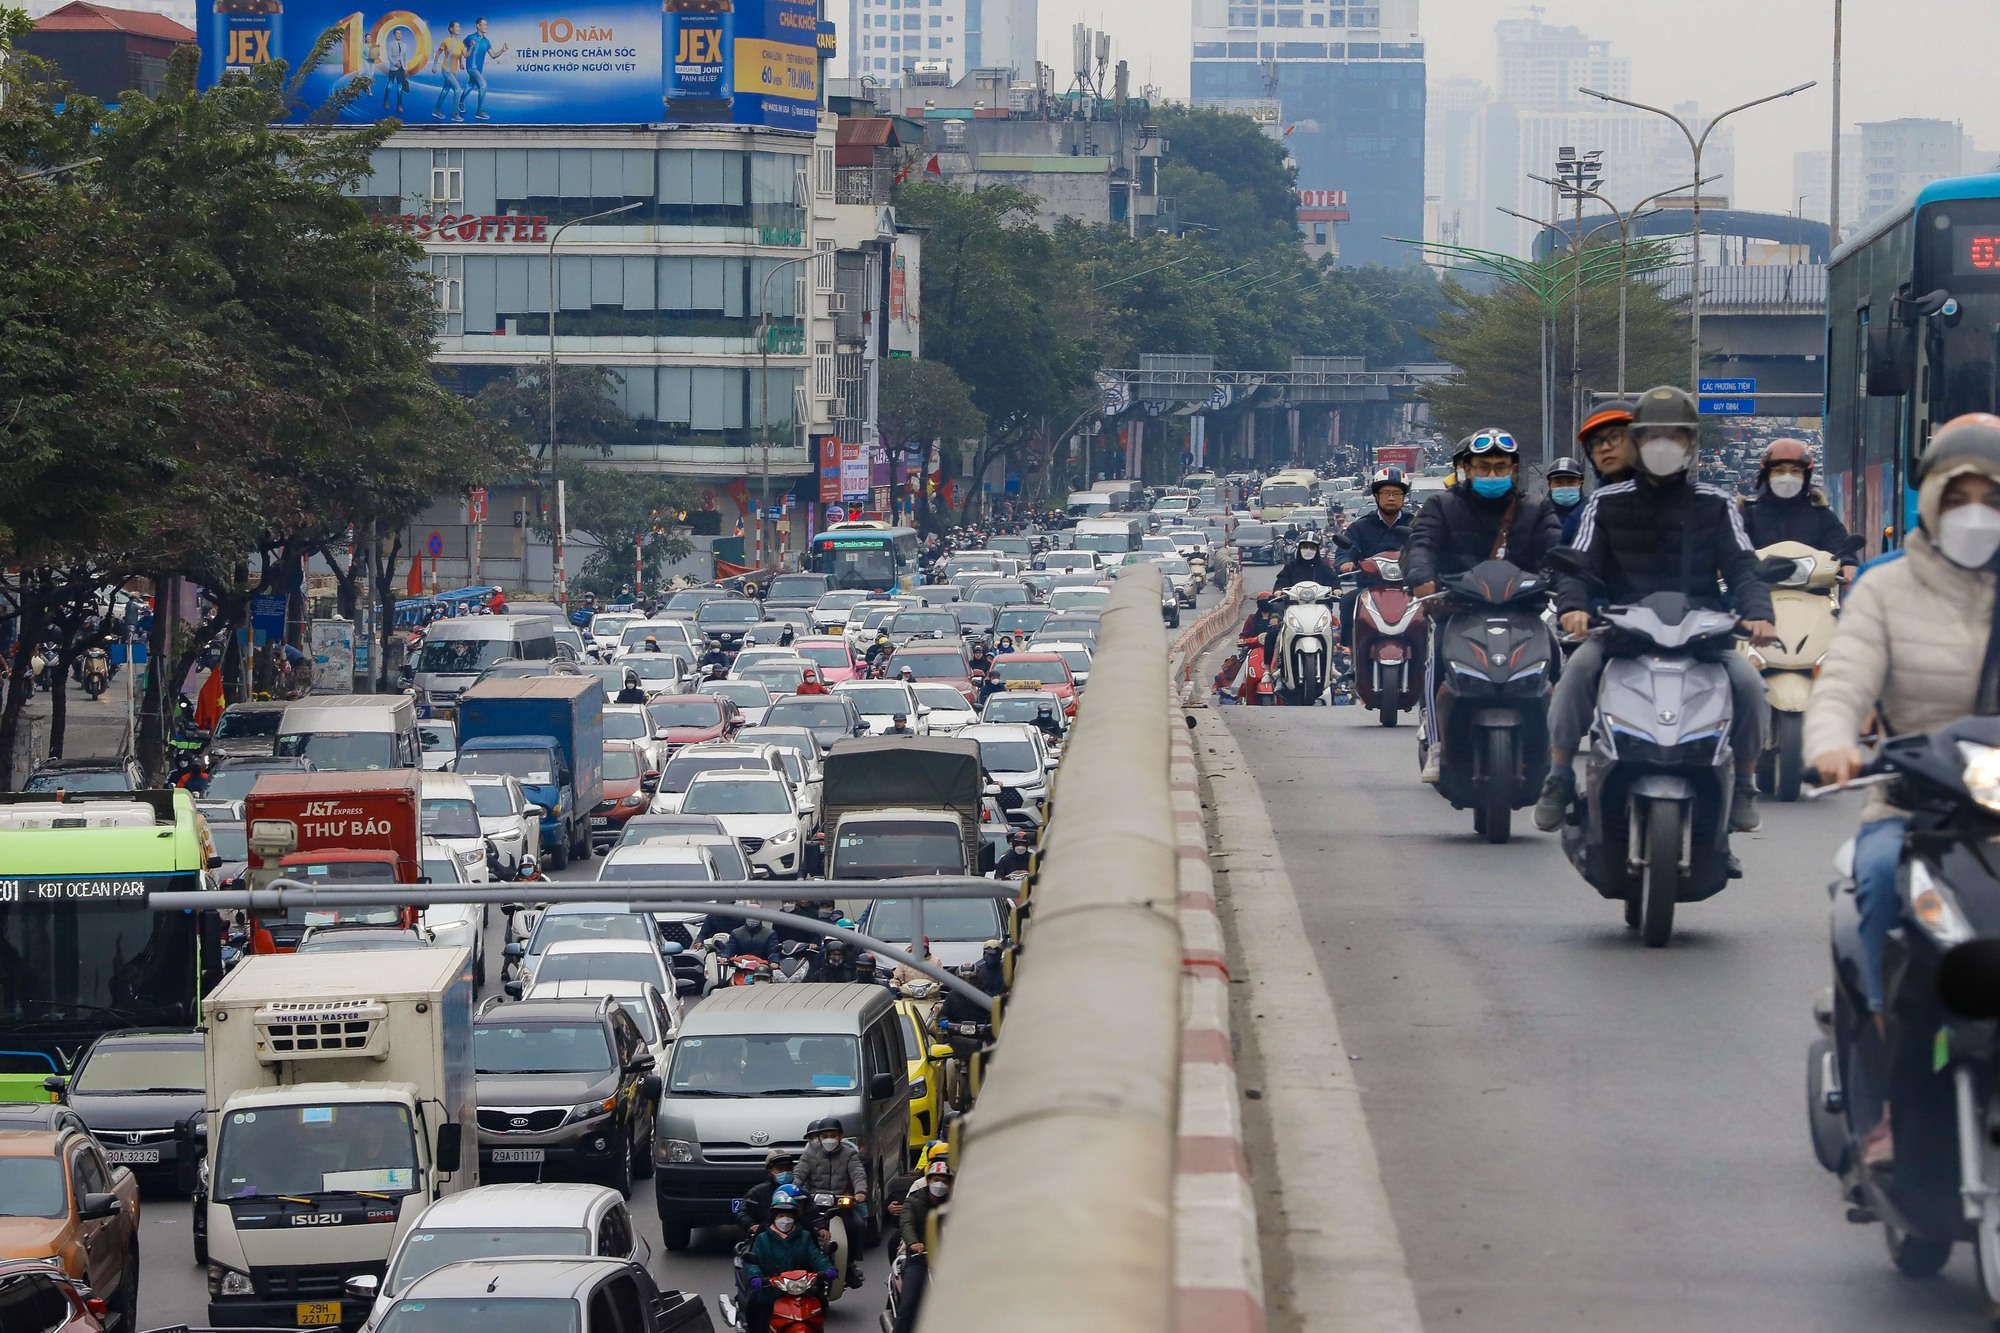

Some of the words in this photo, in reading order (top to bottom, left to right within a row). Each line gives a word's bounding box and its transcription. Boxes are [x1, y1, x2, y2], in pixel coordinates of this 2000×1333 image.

[538, 17, 573, 43] 10
[576, 26, 613, 41] NĂM
[225, 30, 272, 64] JEX
[516, 48, 539, 58] TIÊN
[542, 49, 579, 58] PHONG
[581, 47, 612, 57] CHĂM
[614, 46, 636, 57] SÓC
[675, 29, 723, 63] JEX
[516, 63, 550, 72] XƯƠNG
[552, 62, 579, 72] KHỚP
[582, 62, 613, 72] NGƯỜI
[615, 62, 636, 73] VIỆT
[702, 66, 723, 74] JOINT
[761, 66, 773, 84] 60
[438, 214, 548, 242] COFFEE
[1972, 237, 2000, 268] 0
[1702, 381, 1714, 390] CÁC
[299, 801, 340, 817] J&T
[303, 820, 347, 838] THƯ
[351, 817, 391, 836] BÁO
[0, 880, 19, 902] 01
[38, 883, 63, 898] KĐT
[66, 881, 111, 898] OCEAN
[275, 1014, 319, 1023] THERMAL
[322, 1012, 359, 1021] MASTER
[291, 1213, 343, 1226] ISUZU
[309, 1303, 329, 1314] 29H
[302, 1313, 337, 1324] 221.77
